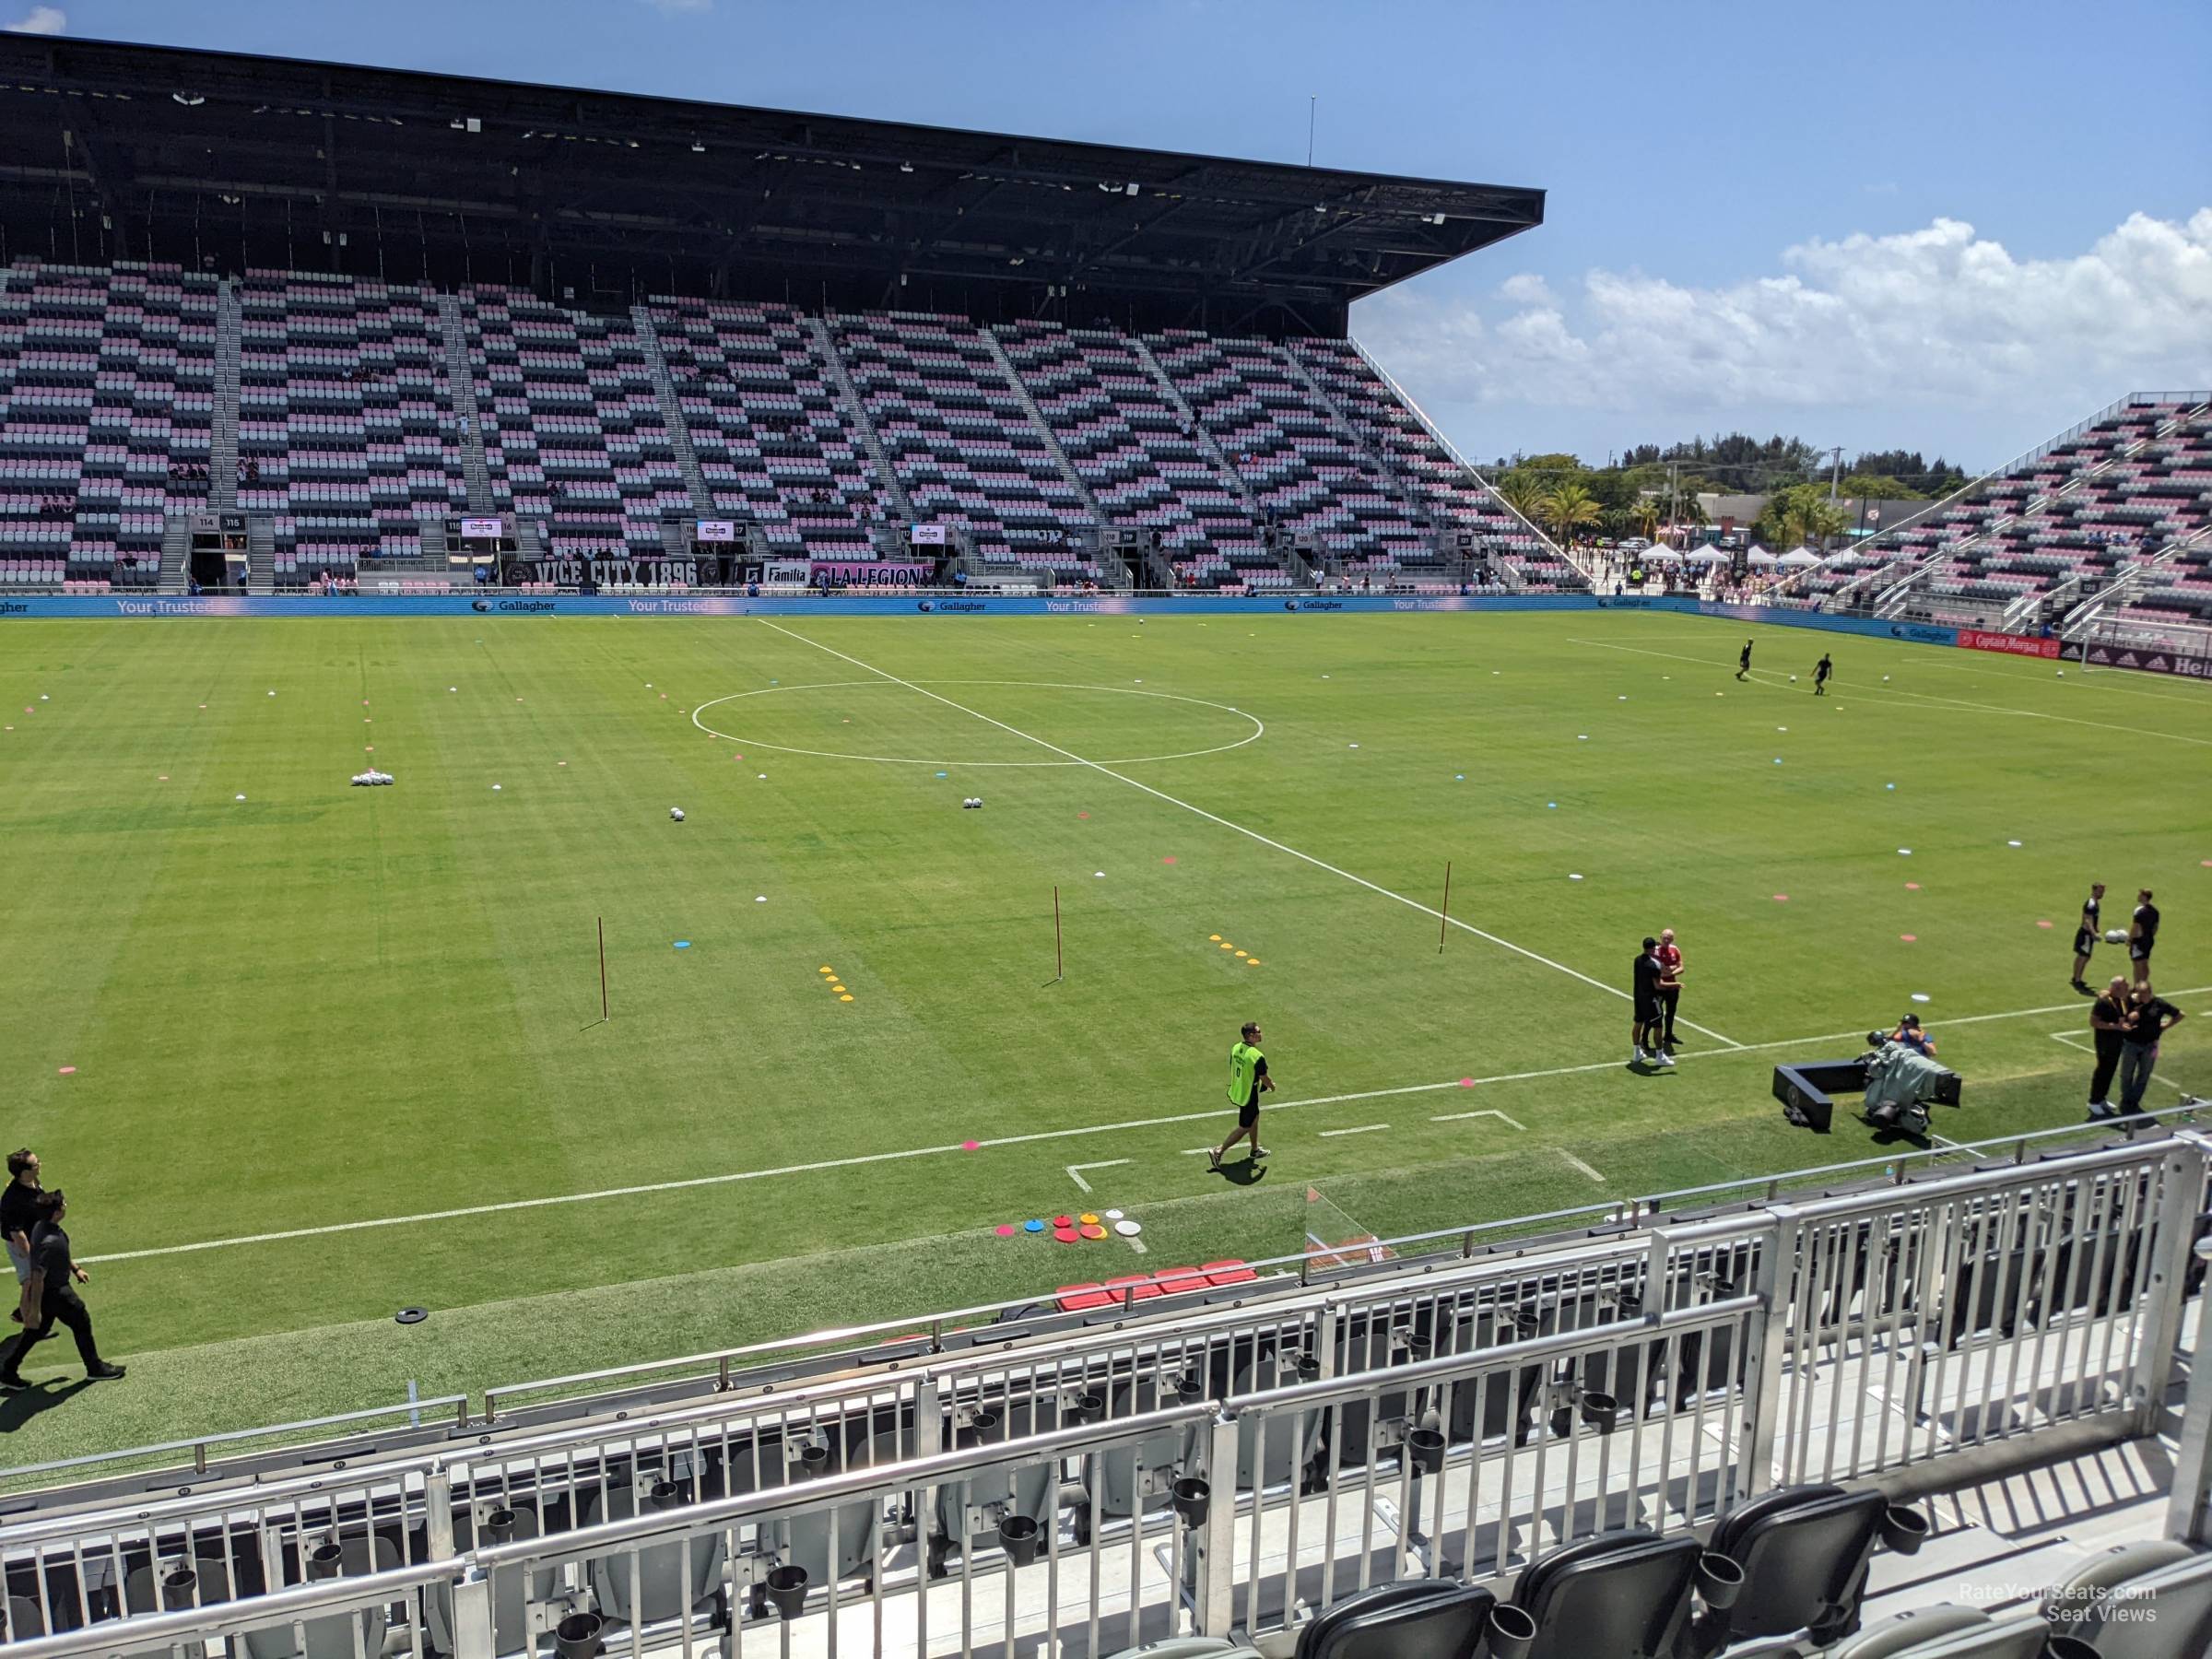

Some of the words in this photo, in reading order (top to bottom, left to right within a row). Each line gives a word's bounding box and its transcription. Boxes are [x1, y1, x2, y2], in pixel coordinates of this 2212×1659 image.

[199, 518, 214, 526] 114
[226, 519, 241, 527] 115
[535, 560, 583, 584] VICE
[590, 561, 641, 584] CITY
[648, 561, 697, 584] 1896
[768, 567, 806, 582] Familia
[830, 567, 851, 585] LA
[856, 568, 922, 586] LEGION
[117, 600, 152, 613] Your
[499, 601, 556, 612] Gallagher
[628, 599, 658, 612] Your
[939, 601, 986, 612] Gallagher
[1046, 601, 1069, 612] Your
[1302, 601, 1343, 611] Gallagher
[1975, 634, 2007, 650] Captain
[2005, 636, 2040, 653] Morgan
